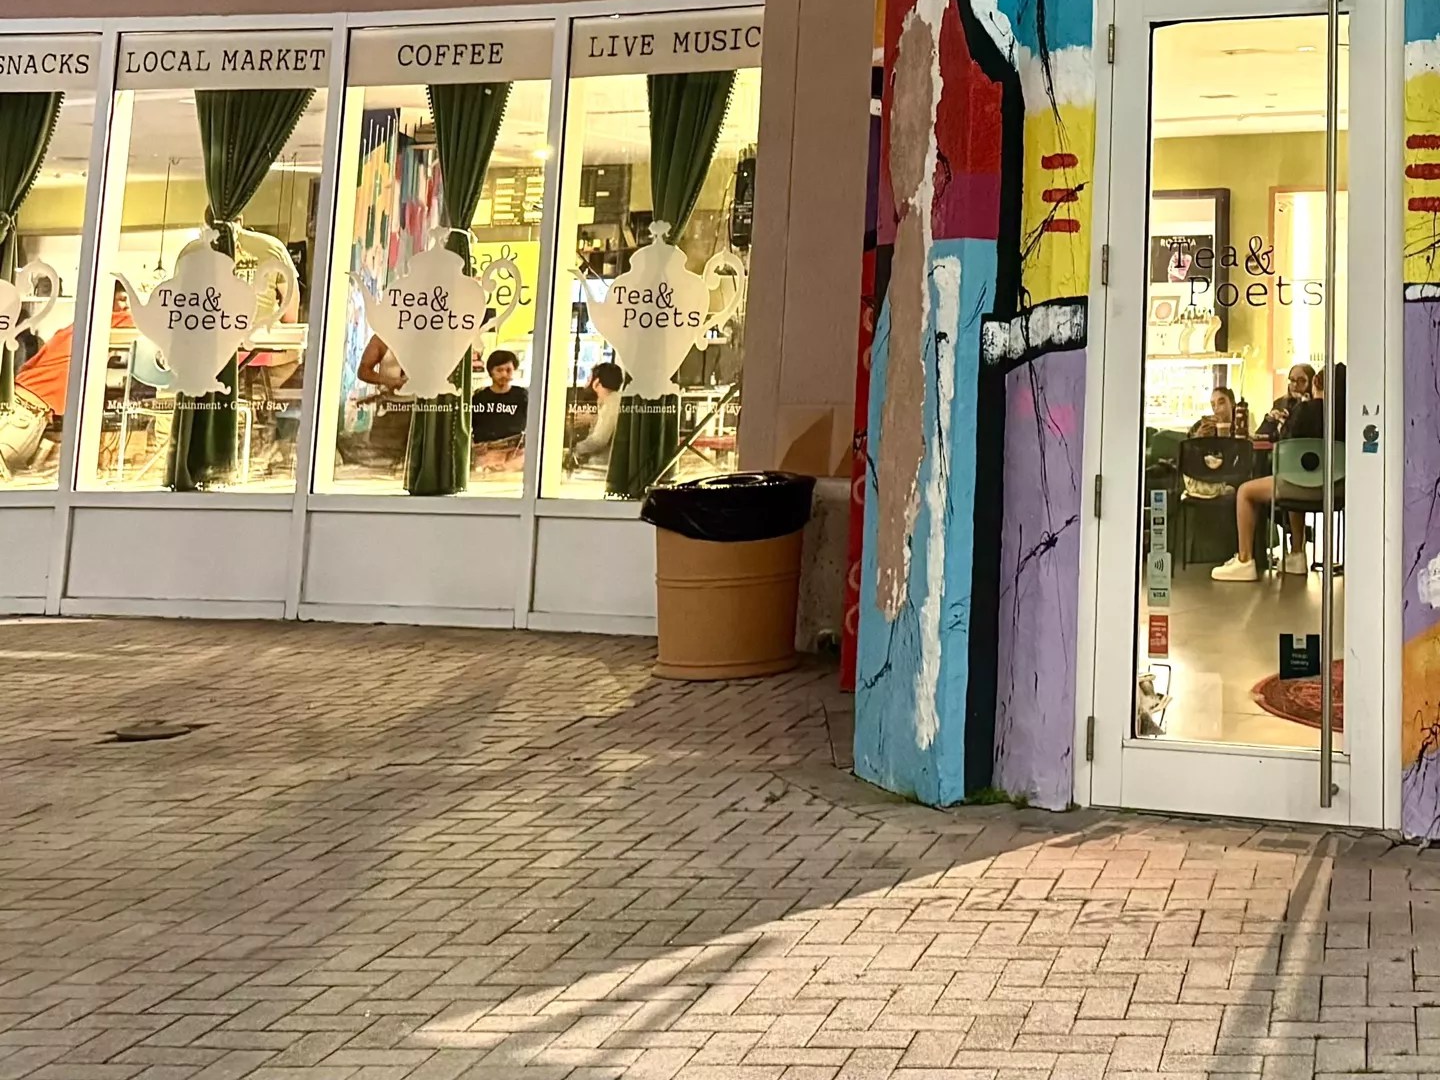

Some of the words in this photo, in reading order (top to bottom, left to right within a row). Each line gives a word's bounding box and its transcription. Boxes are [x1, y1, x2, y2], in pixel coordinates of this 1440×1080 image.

[397, 42, 504, 67] COFFEE
[588, 34, 656, 58] LIVE
[673, 26, 762, 54] MUSIC
[125, 50, 211, 74] LOCAL
[221, 48, 326, 72] MARKET
[1169, 235, 1276, 276] Tea&
[159, 286, 222, 312] Tea&
[388, 286, 450, 312] Tea&
[613, 282, 675, 309] Tea&
[1189, 275, 1324, 307] Poets
[167, 310, 249, 330] Poets
[397, 309, 475, 331] Poets
[623, 307, 701, 328] Poets
[266, 401, 289, 413] Stay
[386, 402, 453, 413] Entertainment
[462, 403, 485, 413] Grub
[487, 403, 494, 413] N
[496, 402, 518, 414] Stay
[568, 403, 597, 414] Marke
